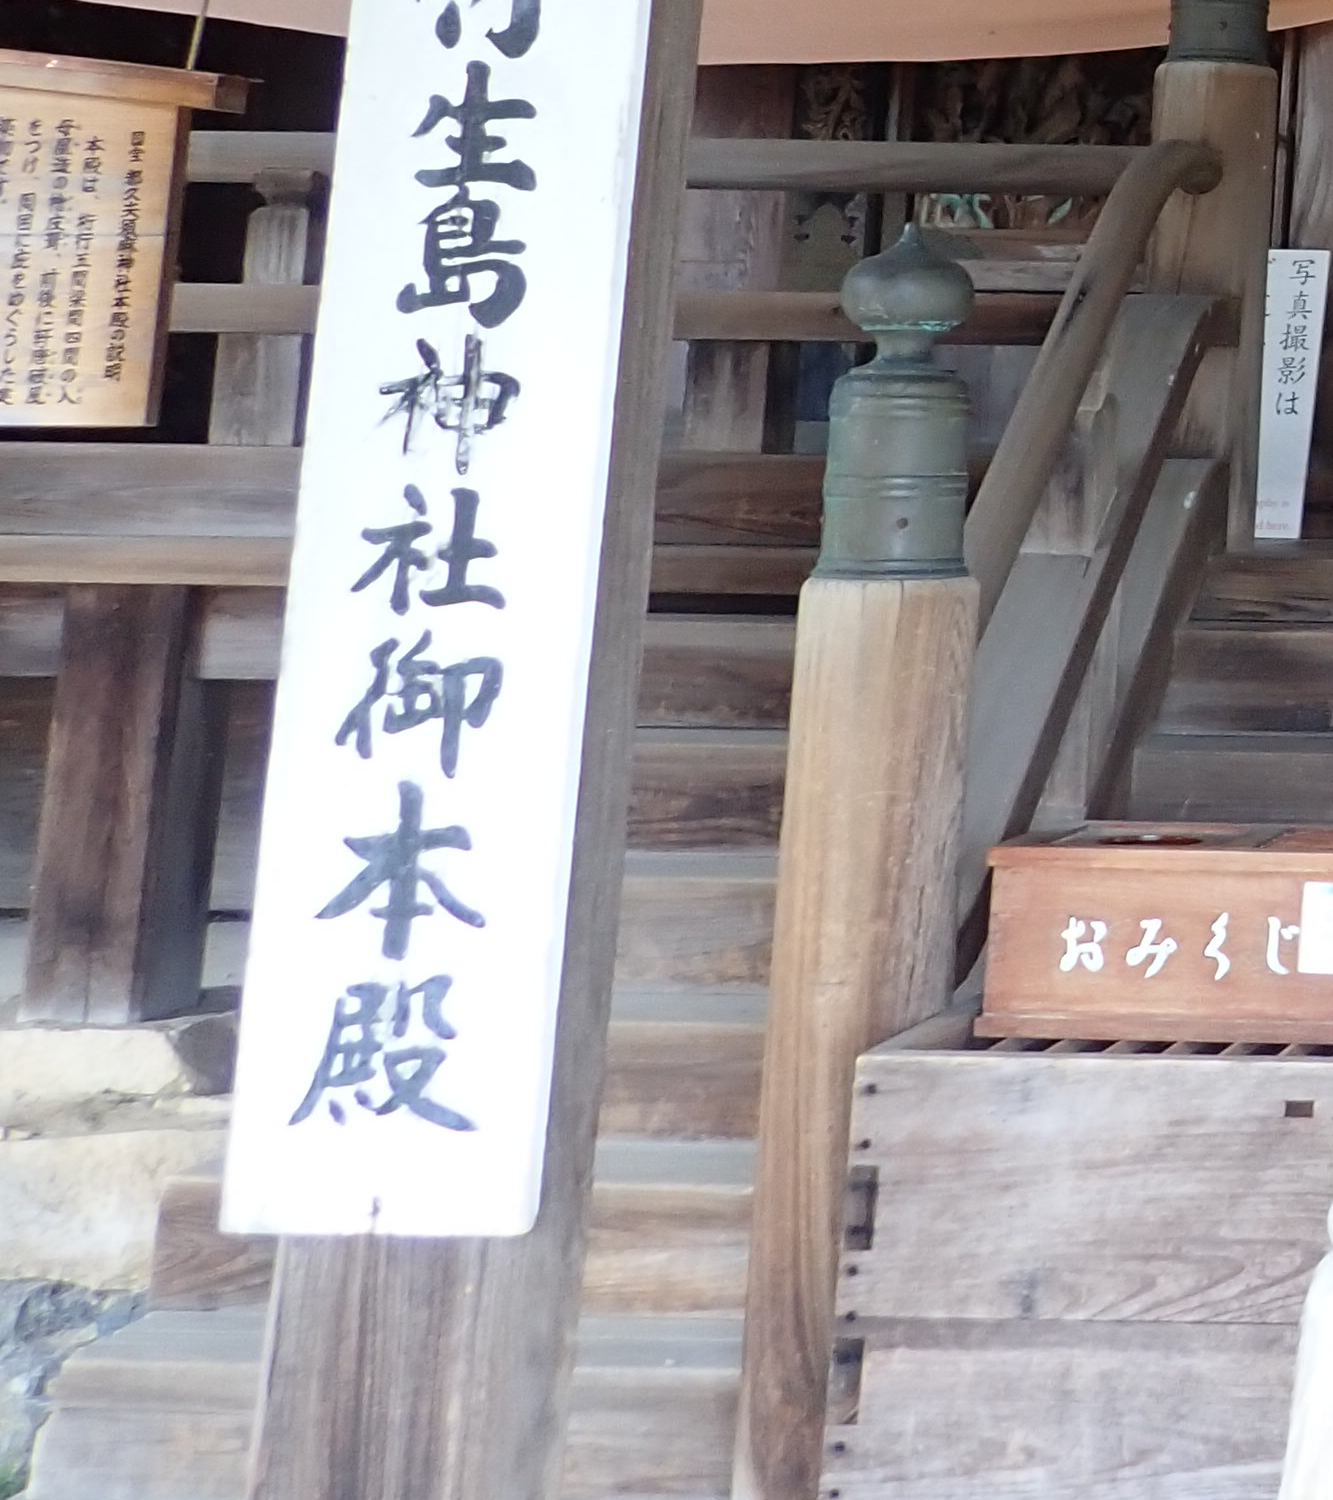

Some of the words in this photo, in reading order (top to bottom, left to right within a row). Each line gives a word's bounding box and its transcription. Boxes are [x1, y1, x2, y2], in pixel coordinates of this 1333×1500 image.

[1275, 258, 1317, 416] 写真撮影は
[1058, 911, 1300, 981] おみくじ
